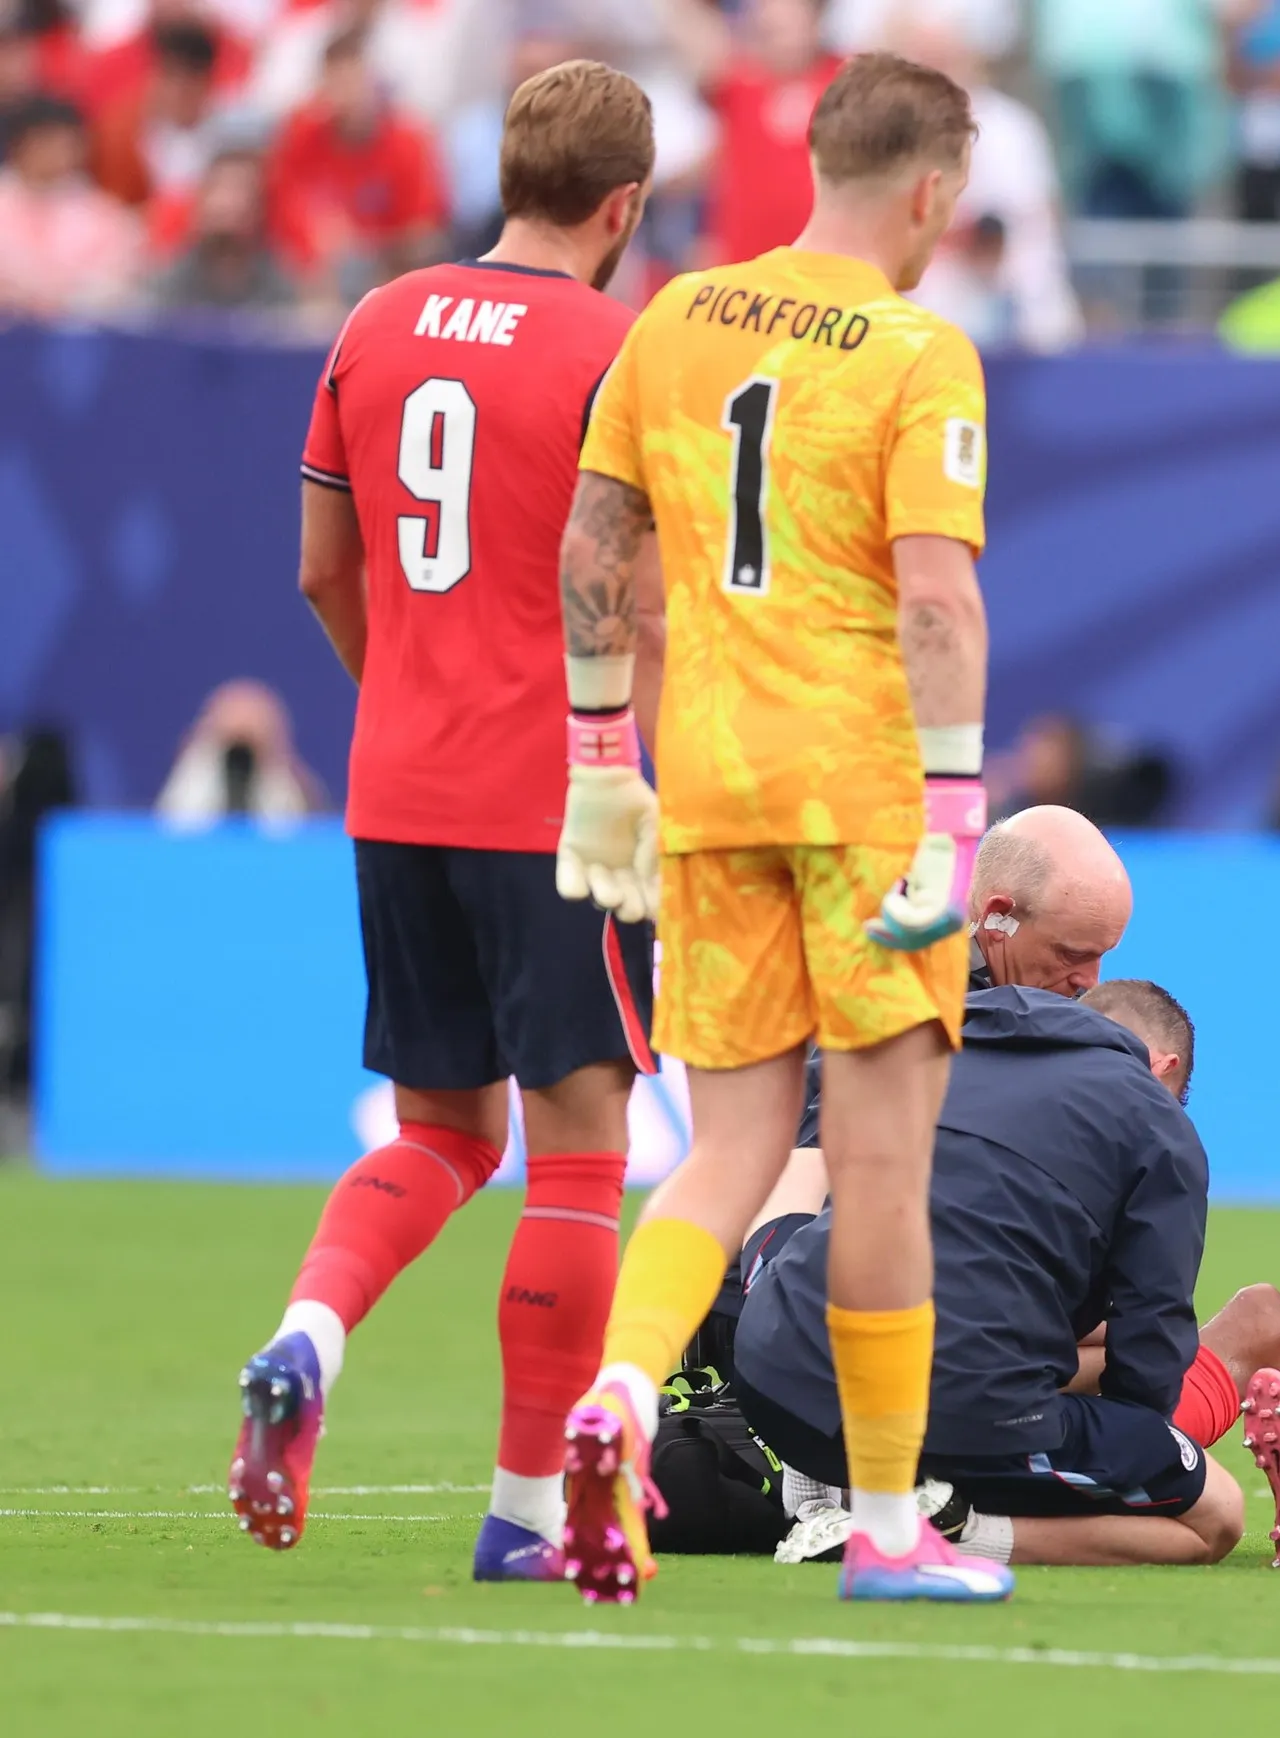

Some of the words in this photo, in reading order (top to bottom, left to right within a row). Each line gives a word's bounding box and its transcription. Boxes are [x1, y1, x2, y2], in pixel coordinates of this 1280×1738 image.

[414, 294, 528, 346] KANE
[687, 285, 870, 352] PICKFORD
[397, 377, 477, 593] 9
[721, 374, 779, 596] 1
[506, 1284, 560, 1309] ENG
